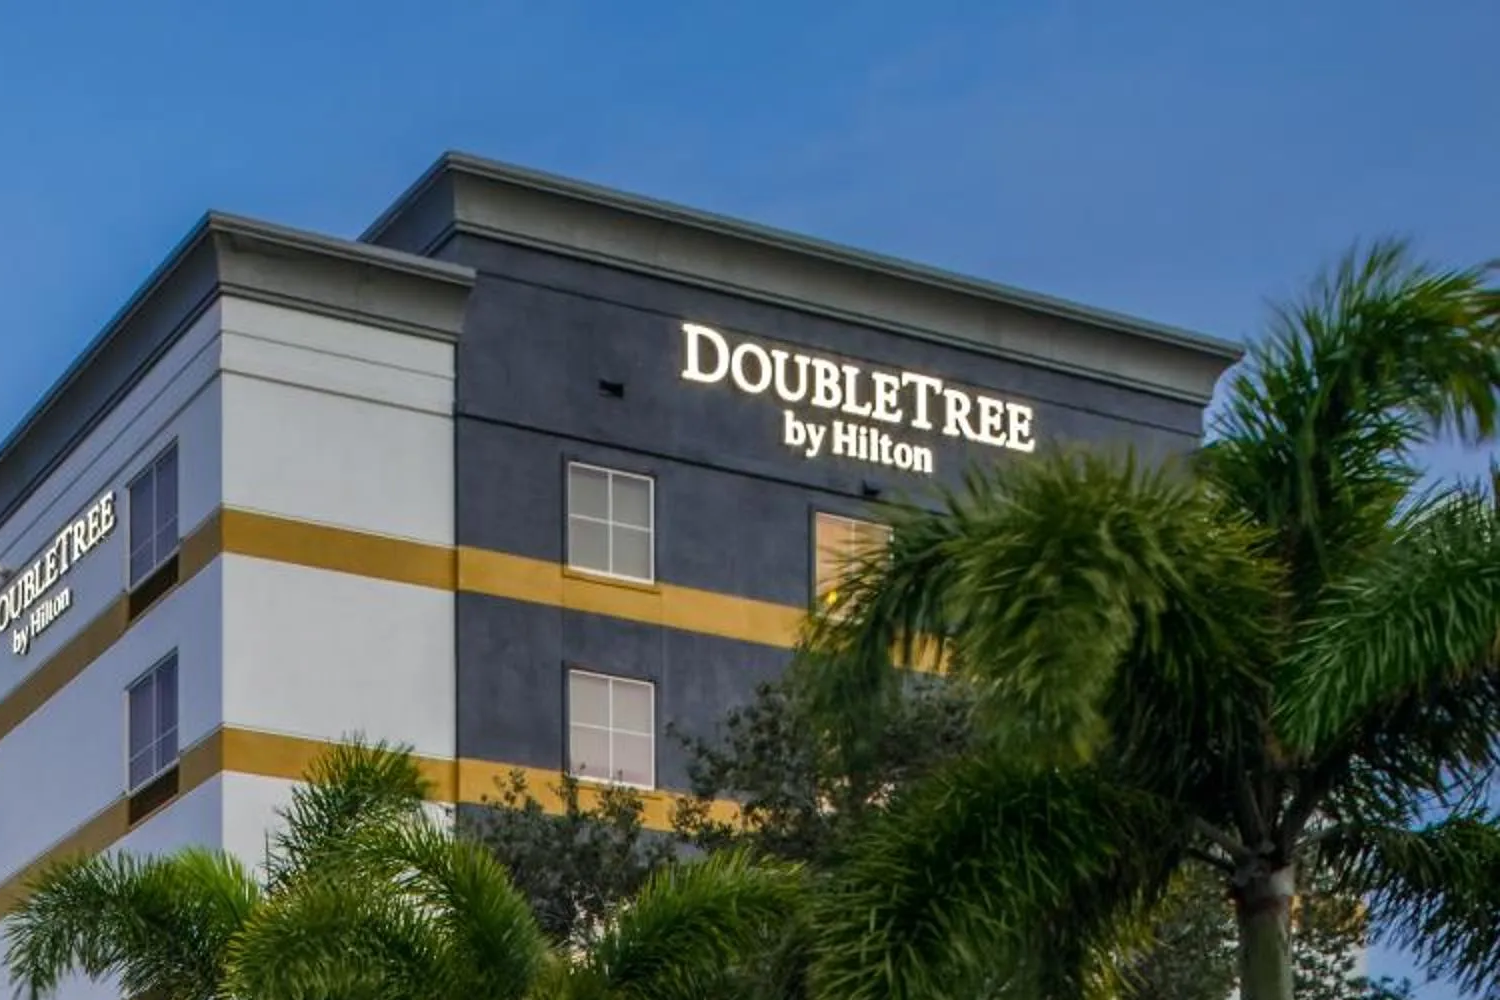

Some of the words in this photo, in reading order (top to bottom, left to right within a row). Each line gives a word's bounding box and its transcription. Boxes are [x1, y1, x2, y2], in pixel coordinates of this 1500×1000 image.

[680, 323, 1036, 453] DOUBLETREE
[784, 410, 826, 457] by
[832, 420, 934, 473] Hilton
[12, 627, 30, 655] by
[31, 586, 71, 637] Hilton
